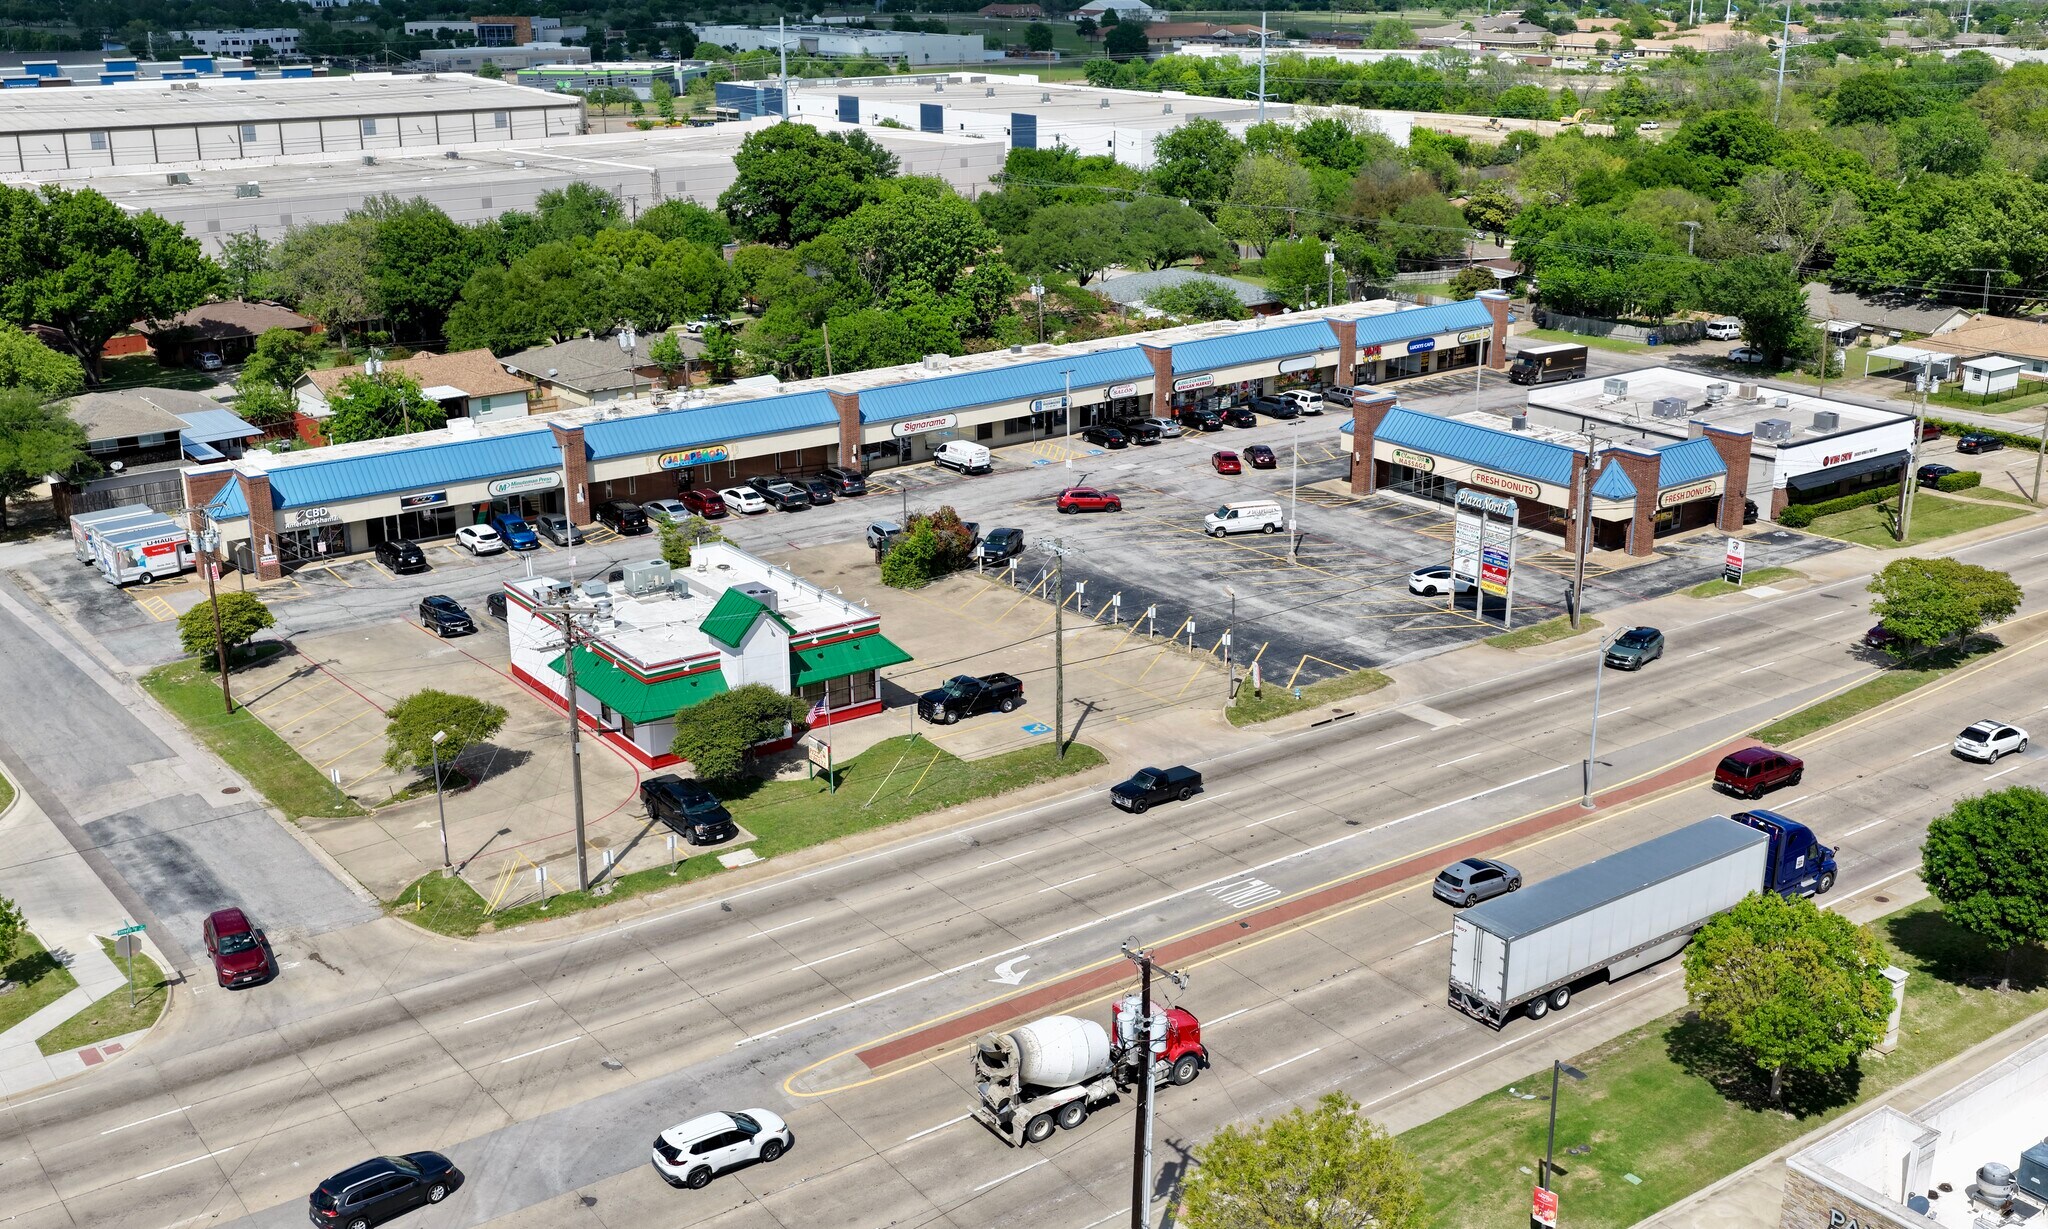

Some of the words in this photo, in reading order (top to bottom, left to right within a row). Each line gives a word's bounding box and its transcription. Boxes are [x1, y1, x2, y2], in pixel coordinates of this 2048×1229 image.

[1177, 383, 1195, 391] AFRICAN
[1195, 380, 1212, 388] MARKET
[904, 418, 946, 432] Signarama
[1399, 457, 1427, 470] MASSAGE
[511, 478, 538, 487] Minuteman
[1476, 473, 1500, 486] FRESH
[1501, 479, 1534, 495] DONUTS
[1665, 491, 1685, 504] FRESH
[1685, 485, 1712, 499] DONUTS
[1458, 491, 1482, 509] Plaza
[1481, 496, 1510, 516] North
[305, 507, 328, 519] CBD
[285, 518, 316, 530] American
[146, 537, 175, 546] U-HAUL
[1206, 877, 1282, 908] ONLY
